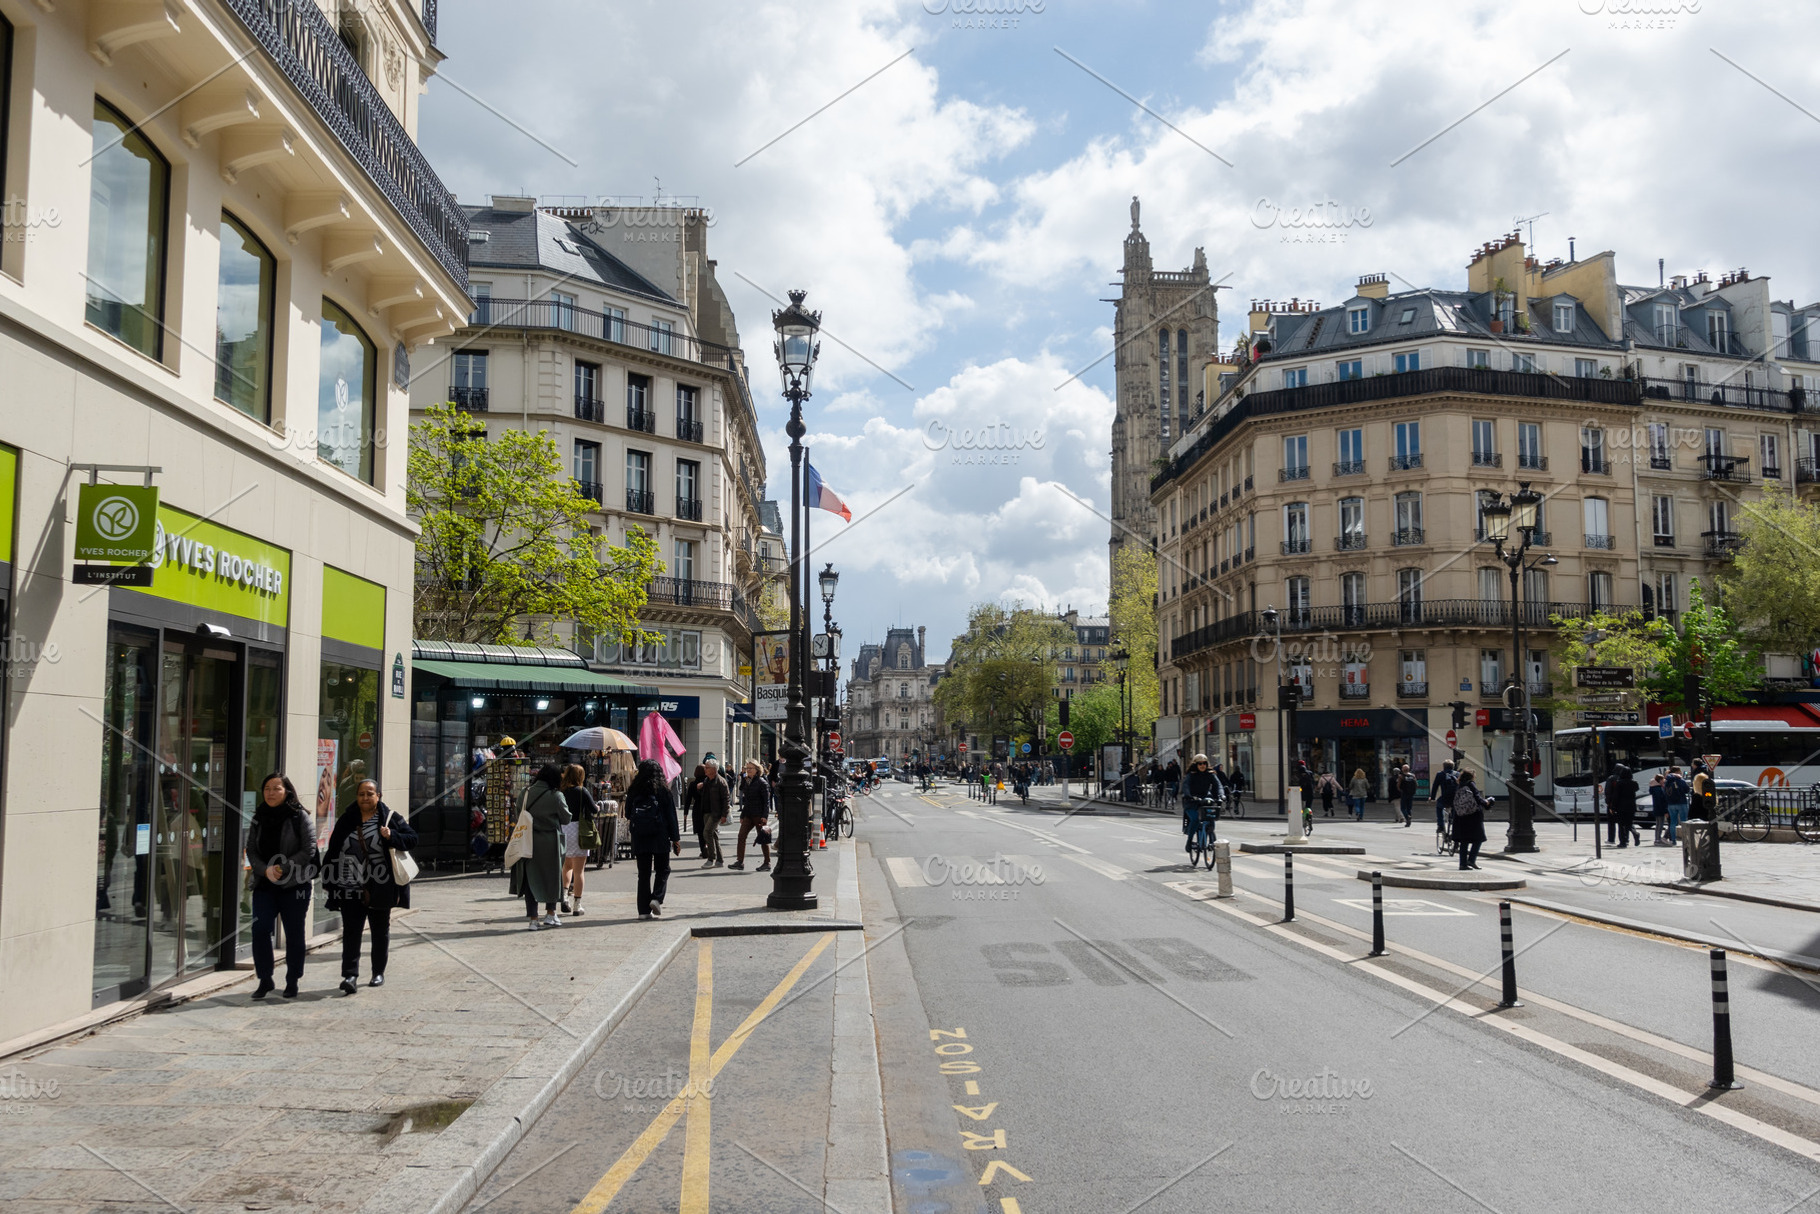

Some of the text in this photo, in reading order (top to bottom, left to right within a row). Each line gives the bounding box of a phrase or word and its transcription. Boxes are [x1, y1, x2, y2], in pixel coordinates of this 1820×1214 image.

[80, 548, 149, 557] YVES ROCHER
[167, 533, 282, 595] YVES ROCHER
[88, 572, 137, 580] L'INSTITUT
[757, 685, 788, 701] Basqui
[1340, 718, 1370, 728] HEMA
